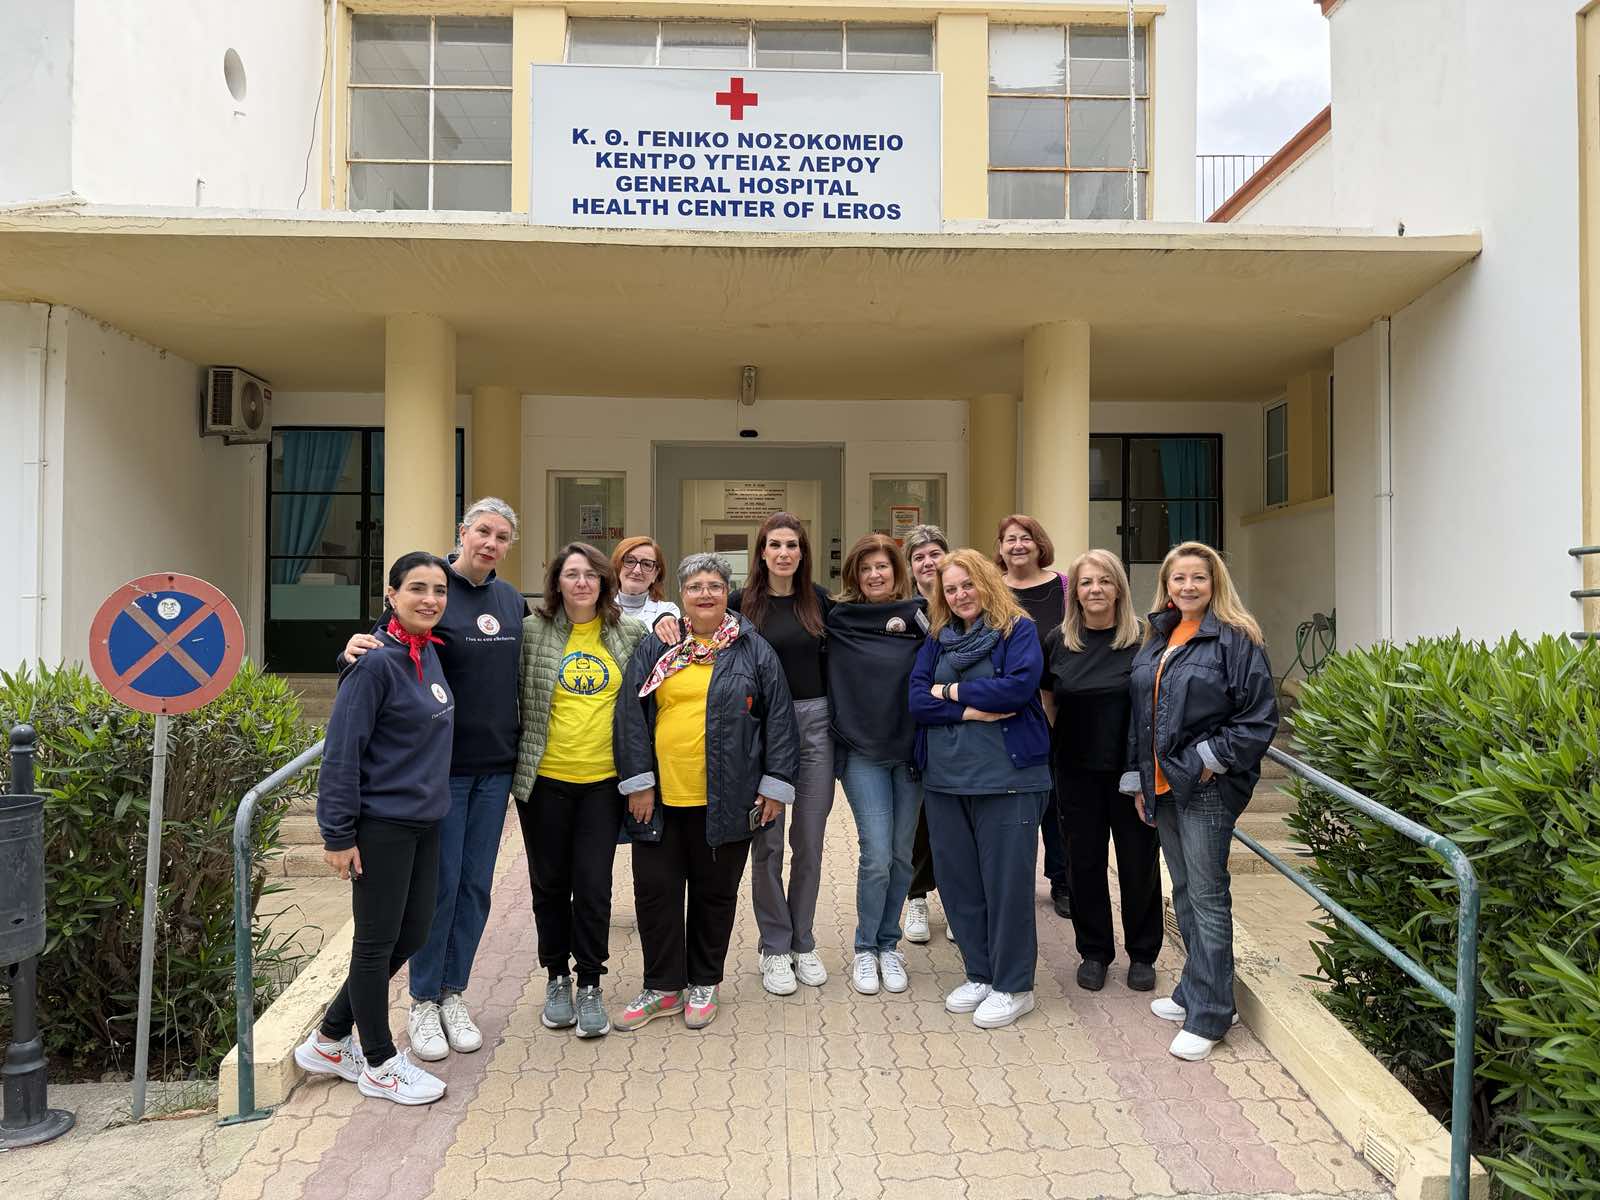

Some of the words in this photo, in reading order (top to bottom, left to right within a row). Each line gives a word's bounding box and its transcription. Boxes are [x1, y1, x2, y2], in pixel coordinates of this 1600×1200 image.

[572, 128, 596, 145] Κ.
[604, 129, 629, 146] Θ.
[638, 131, 729, 149] ΓΕΝΙΚΟ
[737, 132, 904, 151] ΝΟΣΟΚΟΜΕΙΟ
[595, 152, 696, 170] ΚΕΝΤΡΟ
[704, 154, 791, 172] ΥΓΕΙΑΣ
[799, 156, 881, 174] ΛΕΡΟΥ
[615, 175, 731, 194] GENERAL
[739, 176, 859, 197] HOSPITAL
[572, 197, 669, 216] HEALTH
[677, 198, 776, 218] CENTER
[783, 201, 815, 219] OF
[822, 202, 902, 221] LEROS
